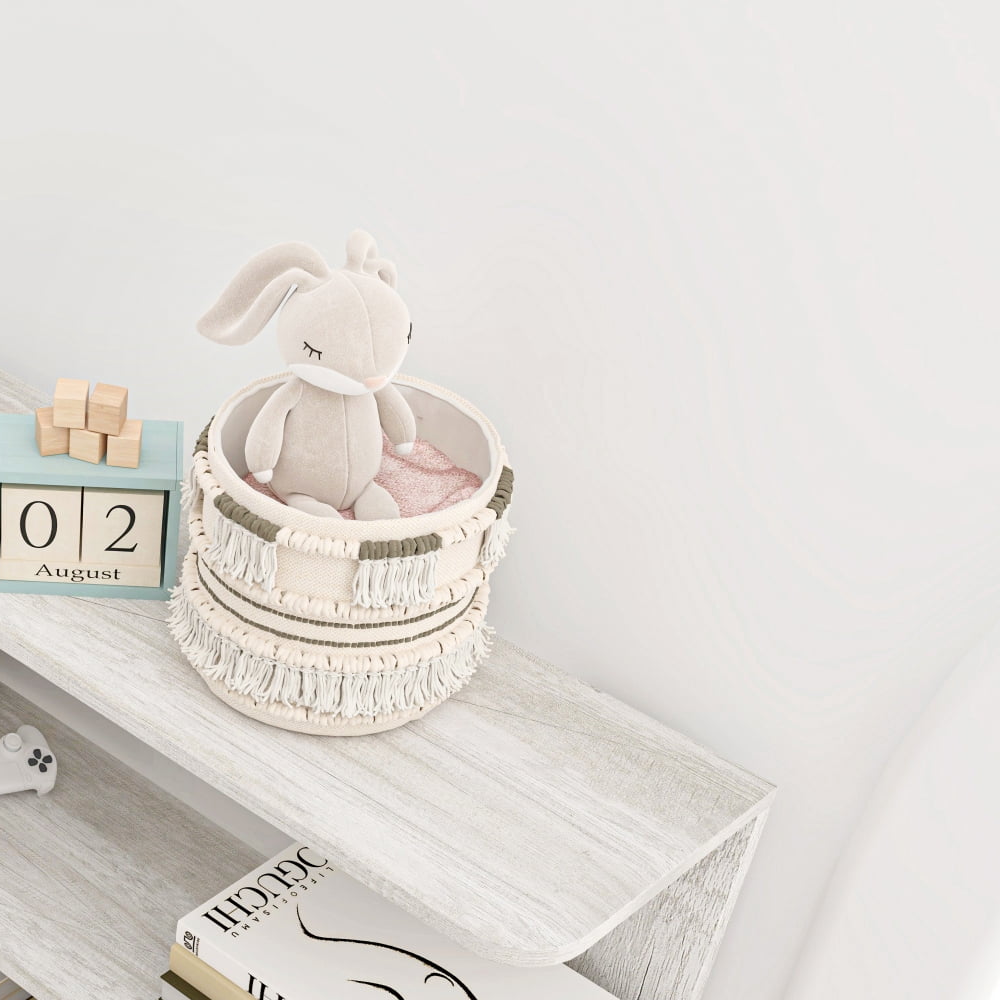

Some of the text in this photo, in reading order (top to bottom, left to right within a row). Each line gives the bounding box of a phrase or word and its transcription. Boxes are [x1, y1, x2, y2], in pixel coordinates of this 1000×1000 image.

[20, 500, 138, 552] 0 2
[34, 563, 121, 583] August
